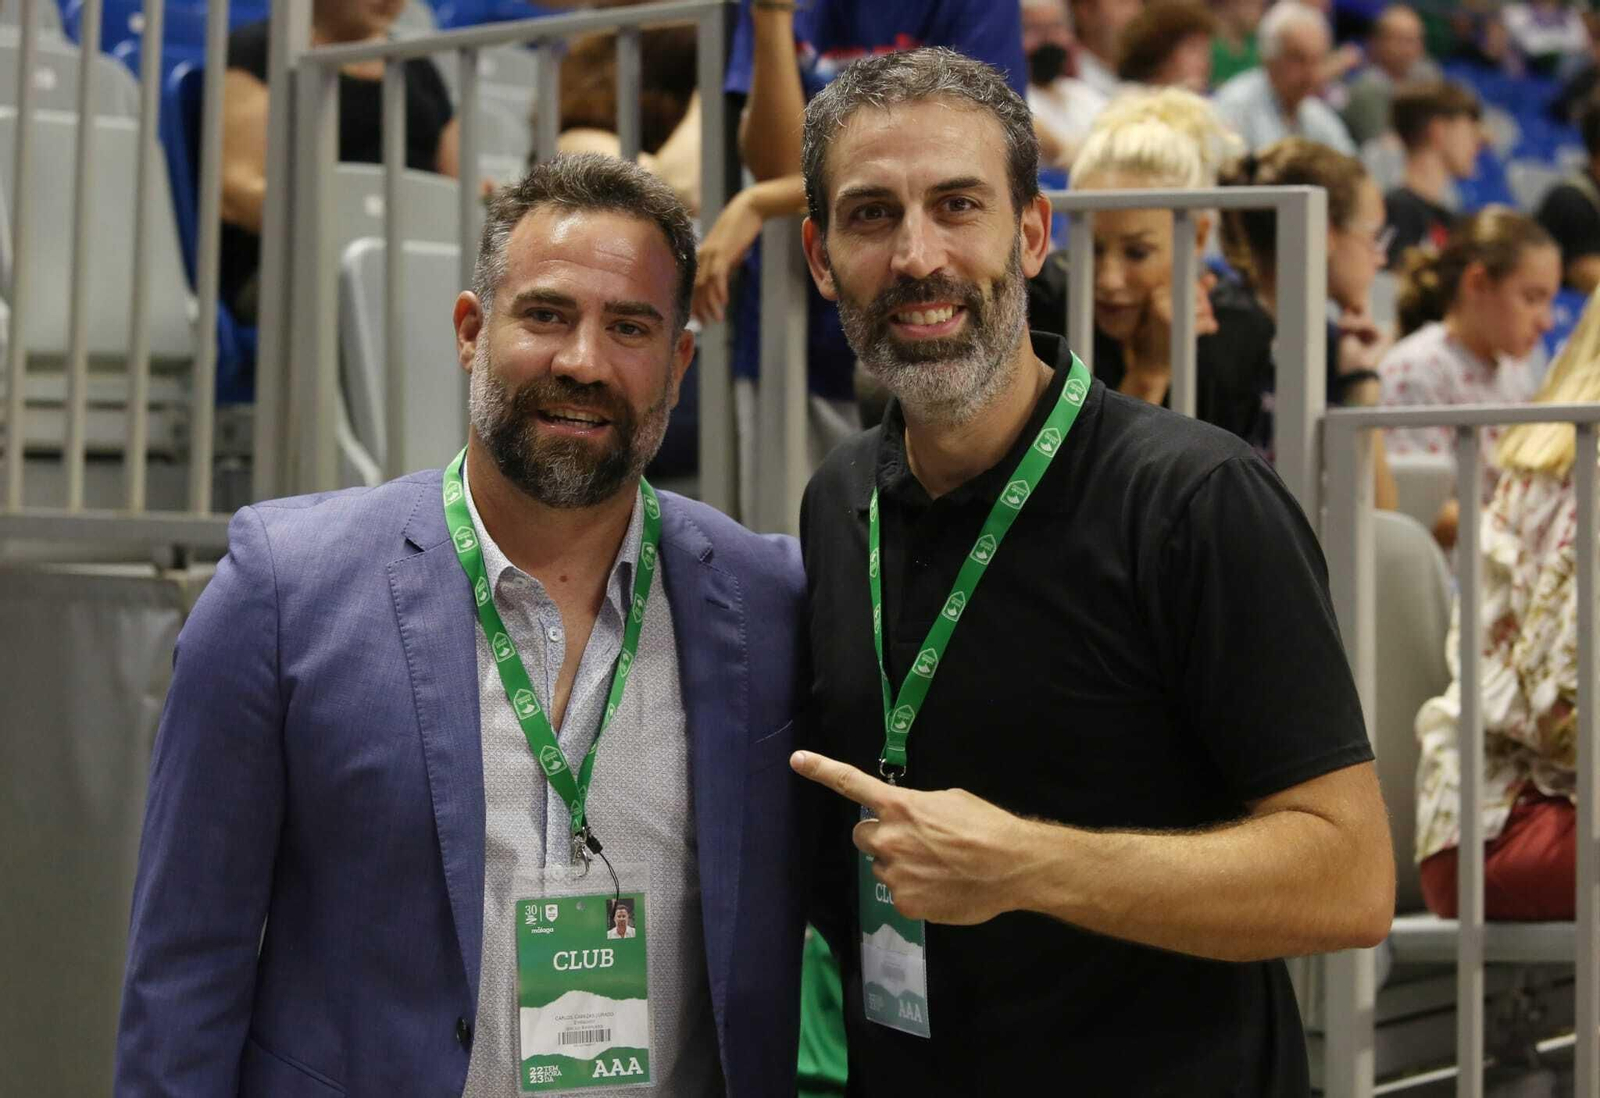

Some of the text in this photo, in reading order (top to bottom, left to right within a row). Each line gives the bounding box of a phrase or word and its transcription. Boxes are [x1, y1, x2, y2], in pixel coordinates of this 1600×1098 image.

[876, 882, 895, 905] CL
[525, 904, 538, 916] 30
[553, 948, 614, 971] CLUB
[899, 999, 923, 1023] AAA
[529, 1066, 544, 1076] 22
[592, 1057, 644, 1078] AAA
[529, 1075, 544, 1084] 23
